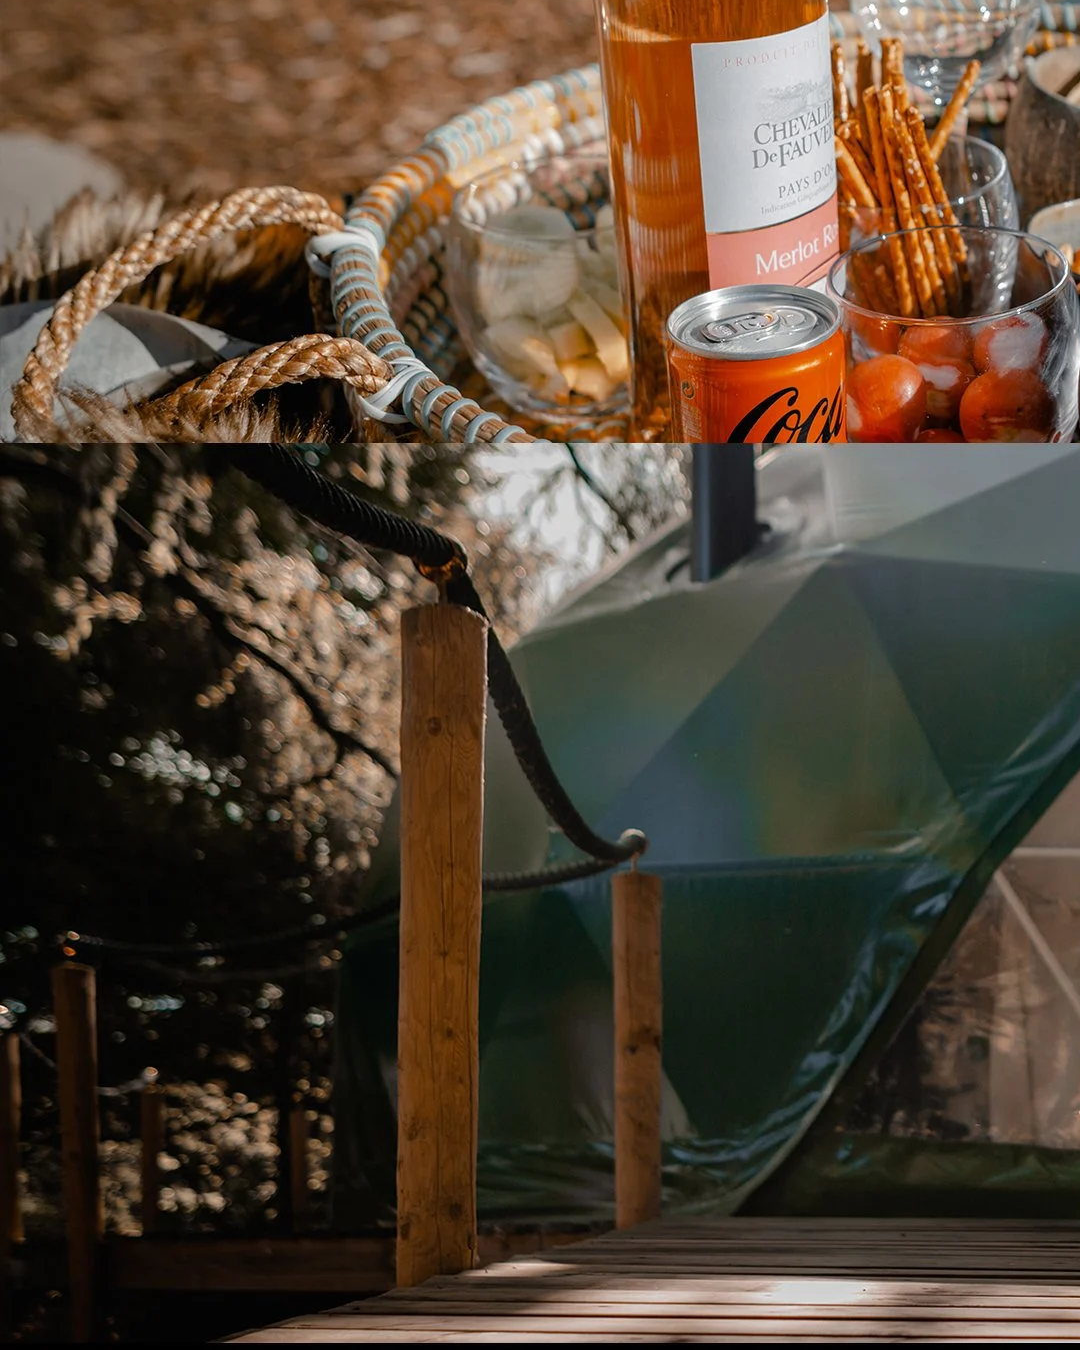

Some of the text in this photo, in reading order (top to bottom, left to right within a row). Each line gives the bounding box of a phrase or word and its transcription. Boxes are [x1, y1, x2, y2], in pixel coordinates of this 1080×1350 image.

[778, 175, 810, 199] PAYS
[813, 163, 835, 185] D'O
[755, 236, 820, 276] Merlot
